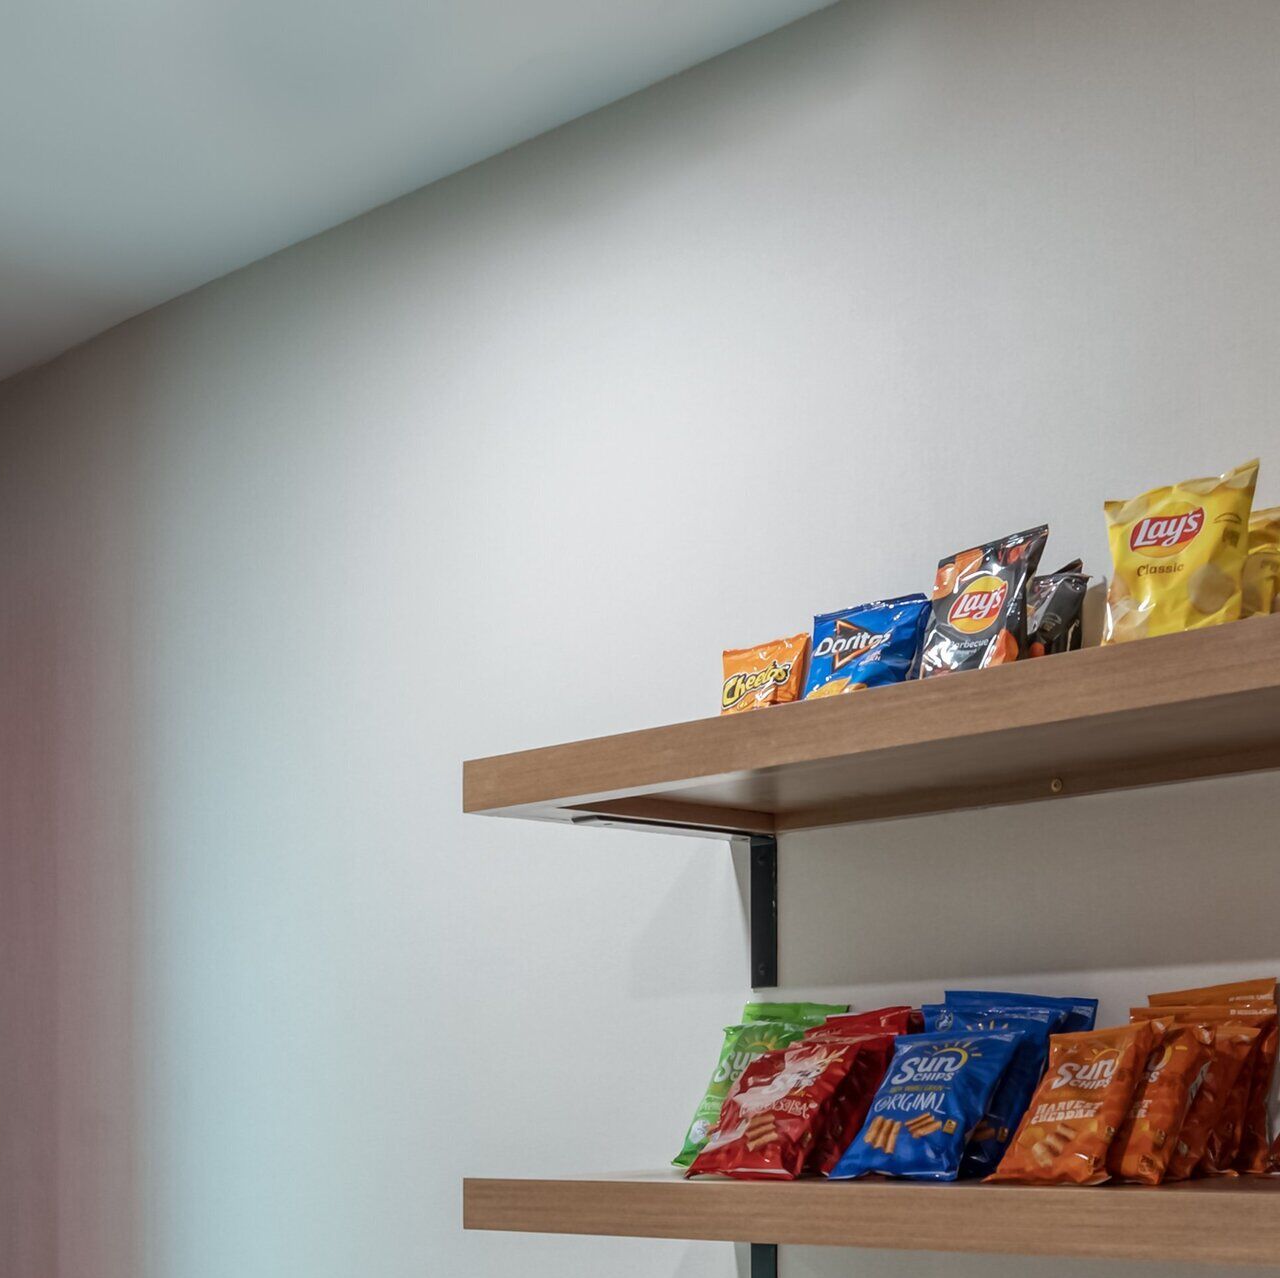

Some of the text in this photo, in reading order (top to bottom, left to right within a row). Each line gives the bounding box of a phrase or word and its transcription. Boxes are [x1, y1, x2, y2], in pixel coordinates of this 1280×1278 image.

[1134, 509, 1205, 549] Lay's
[1136, 562, 1184, 576] Classic
[951, 584, 1009, 620] Lay's
[816, 629, 892, 656] Doritos
[950, 638, 989, 649] Barbecue
[722, 661, 794, 710] Cheetos
[891, 1055, 958, 1084] Sun
[910, 1072, 956, 1082] CHIPS
[1051, 1058, 1114, 1089] Sun
[1070, 1076, 1112, 1089] CHIPS
[874, 1093, 946, 1114] ORIGINAL
[1036, 1099, 1104, 1114] HARVEST
[1031, 1109, 1098, 1124] CHEDDAR
